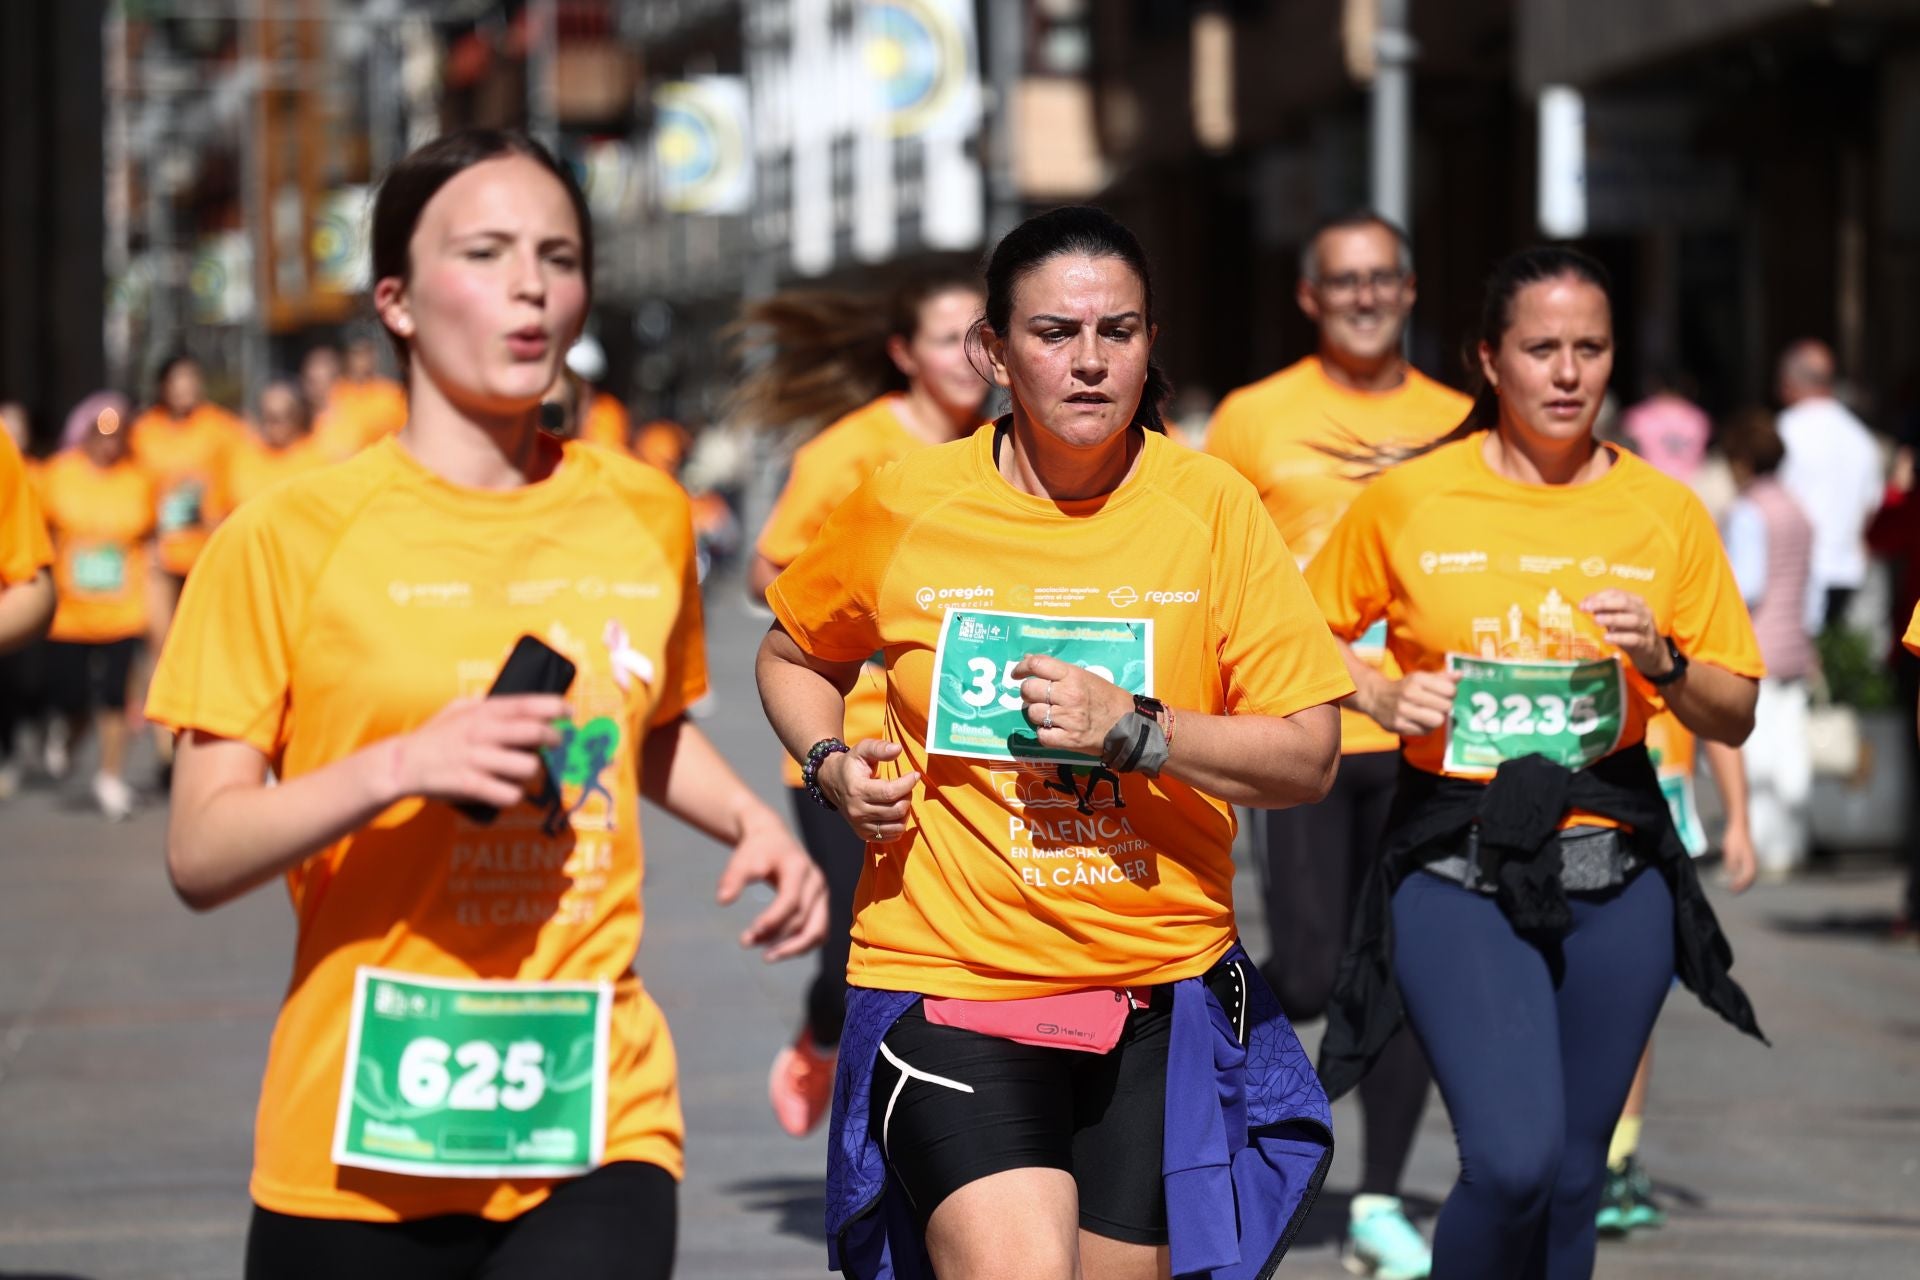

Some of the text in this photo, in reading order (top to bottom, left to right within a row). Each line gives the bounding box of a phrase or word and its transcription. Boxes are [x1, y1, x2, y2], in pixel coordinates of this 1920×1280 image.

[937, 600, 994, 609] comercial
[938, 585, 994, 600] oregón
[1144, 589, 1200, 605] repsol
[961, 656, 1115, 711] 35
[1469, 691, 1600, 736] 2235
[1011, 839, 1151, 859] EN MARCHA CONTRA
[1022, 859, 1149, 888] EL CÁNCER
[397, 1035, 546, 1112] 625
